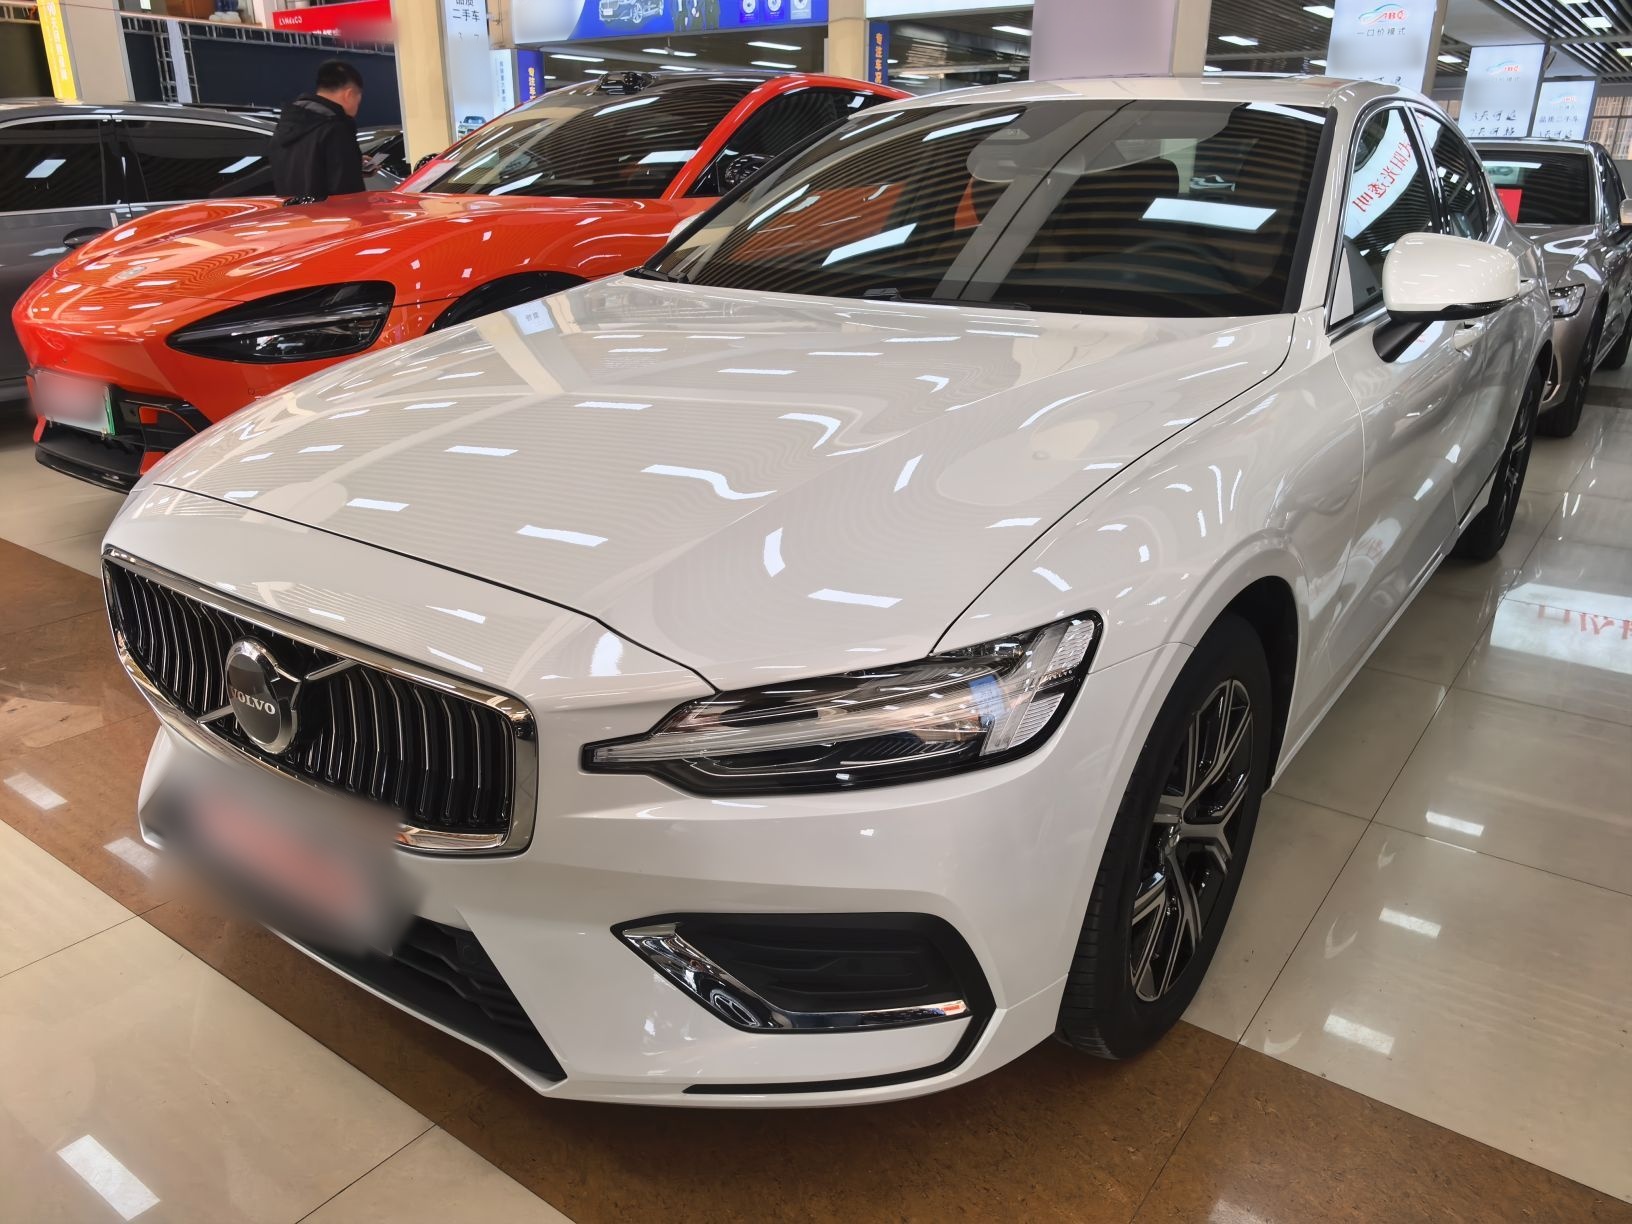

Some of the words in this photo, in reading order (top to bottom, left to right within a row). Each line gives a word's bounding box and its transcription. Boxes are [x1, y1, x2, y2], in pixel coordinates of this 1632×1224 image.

[453, 9, 480, 21] 二手车
[1356, 28, 1406, 37] 一口价模式
[230, 686, 276, 715] VOLVO
